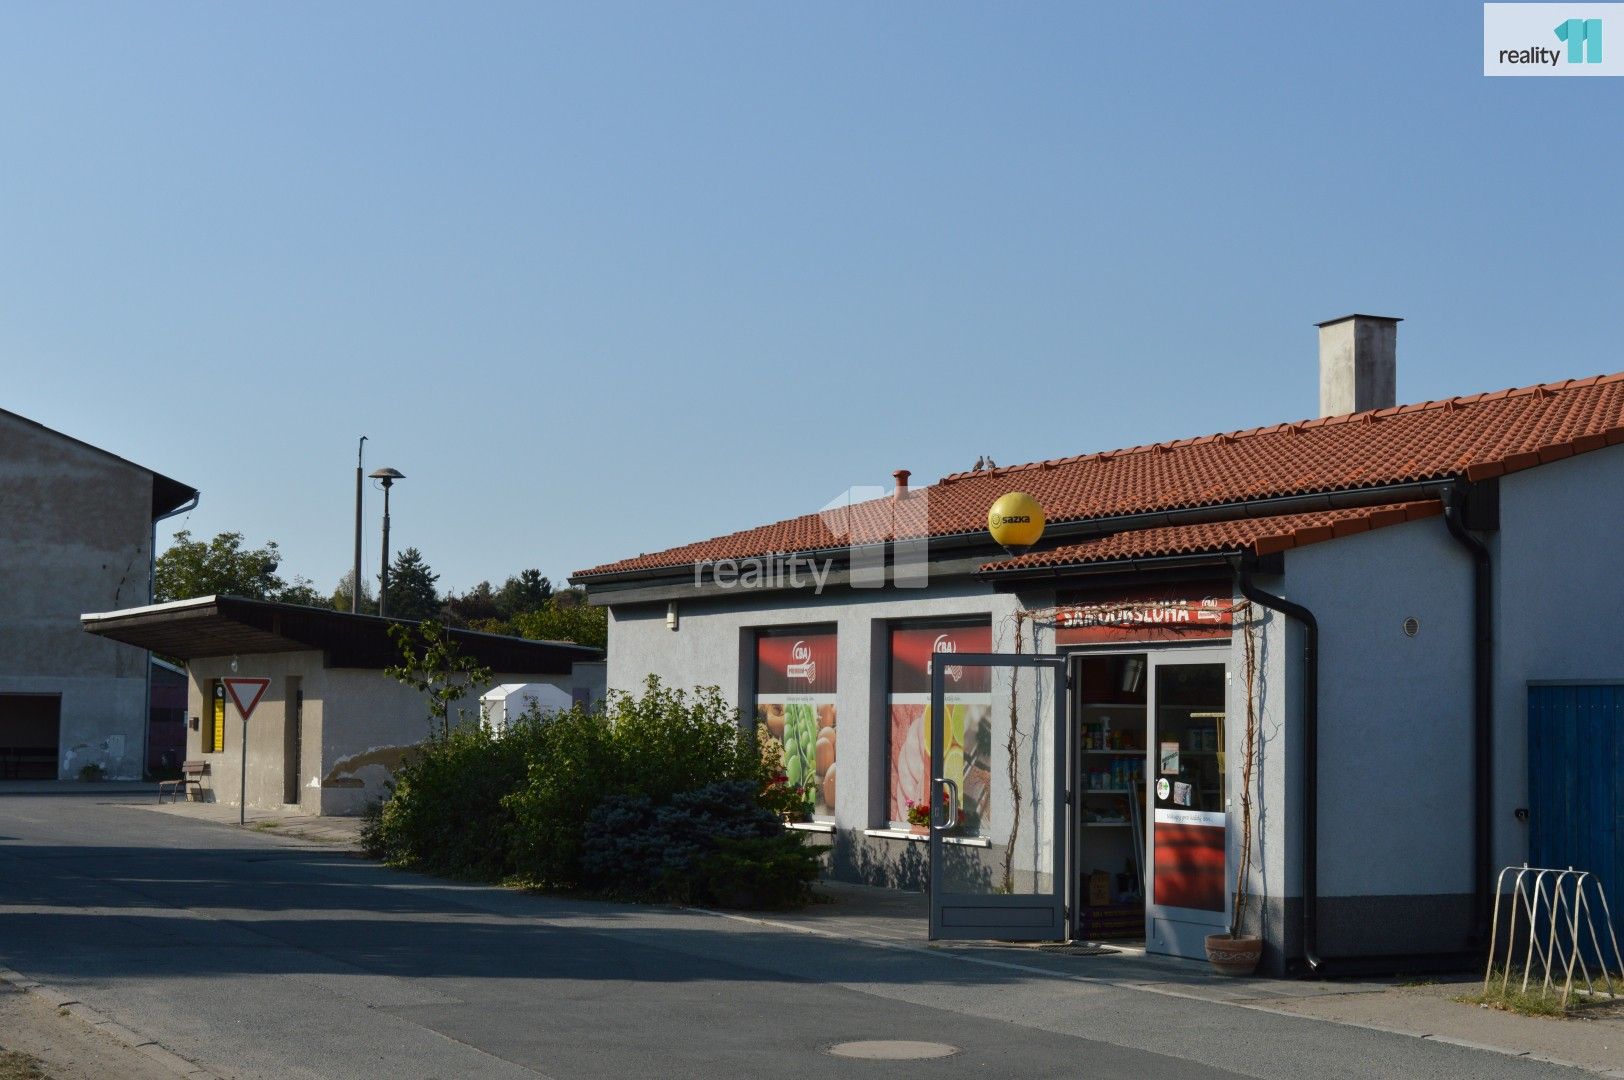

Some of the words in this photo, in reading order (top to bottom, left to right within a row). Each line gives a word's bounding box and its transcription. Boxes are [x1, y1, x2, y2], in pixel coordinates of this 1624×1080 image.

[1002, 515, 1031, 524] sazka
[795, 647, 808, 659] CBA
[937, 641, 952, 653] CBA
